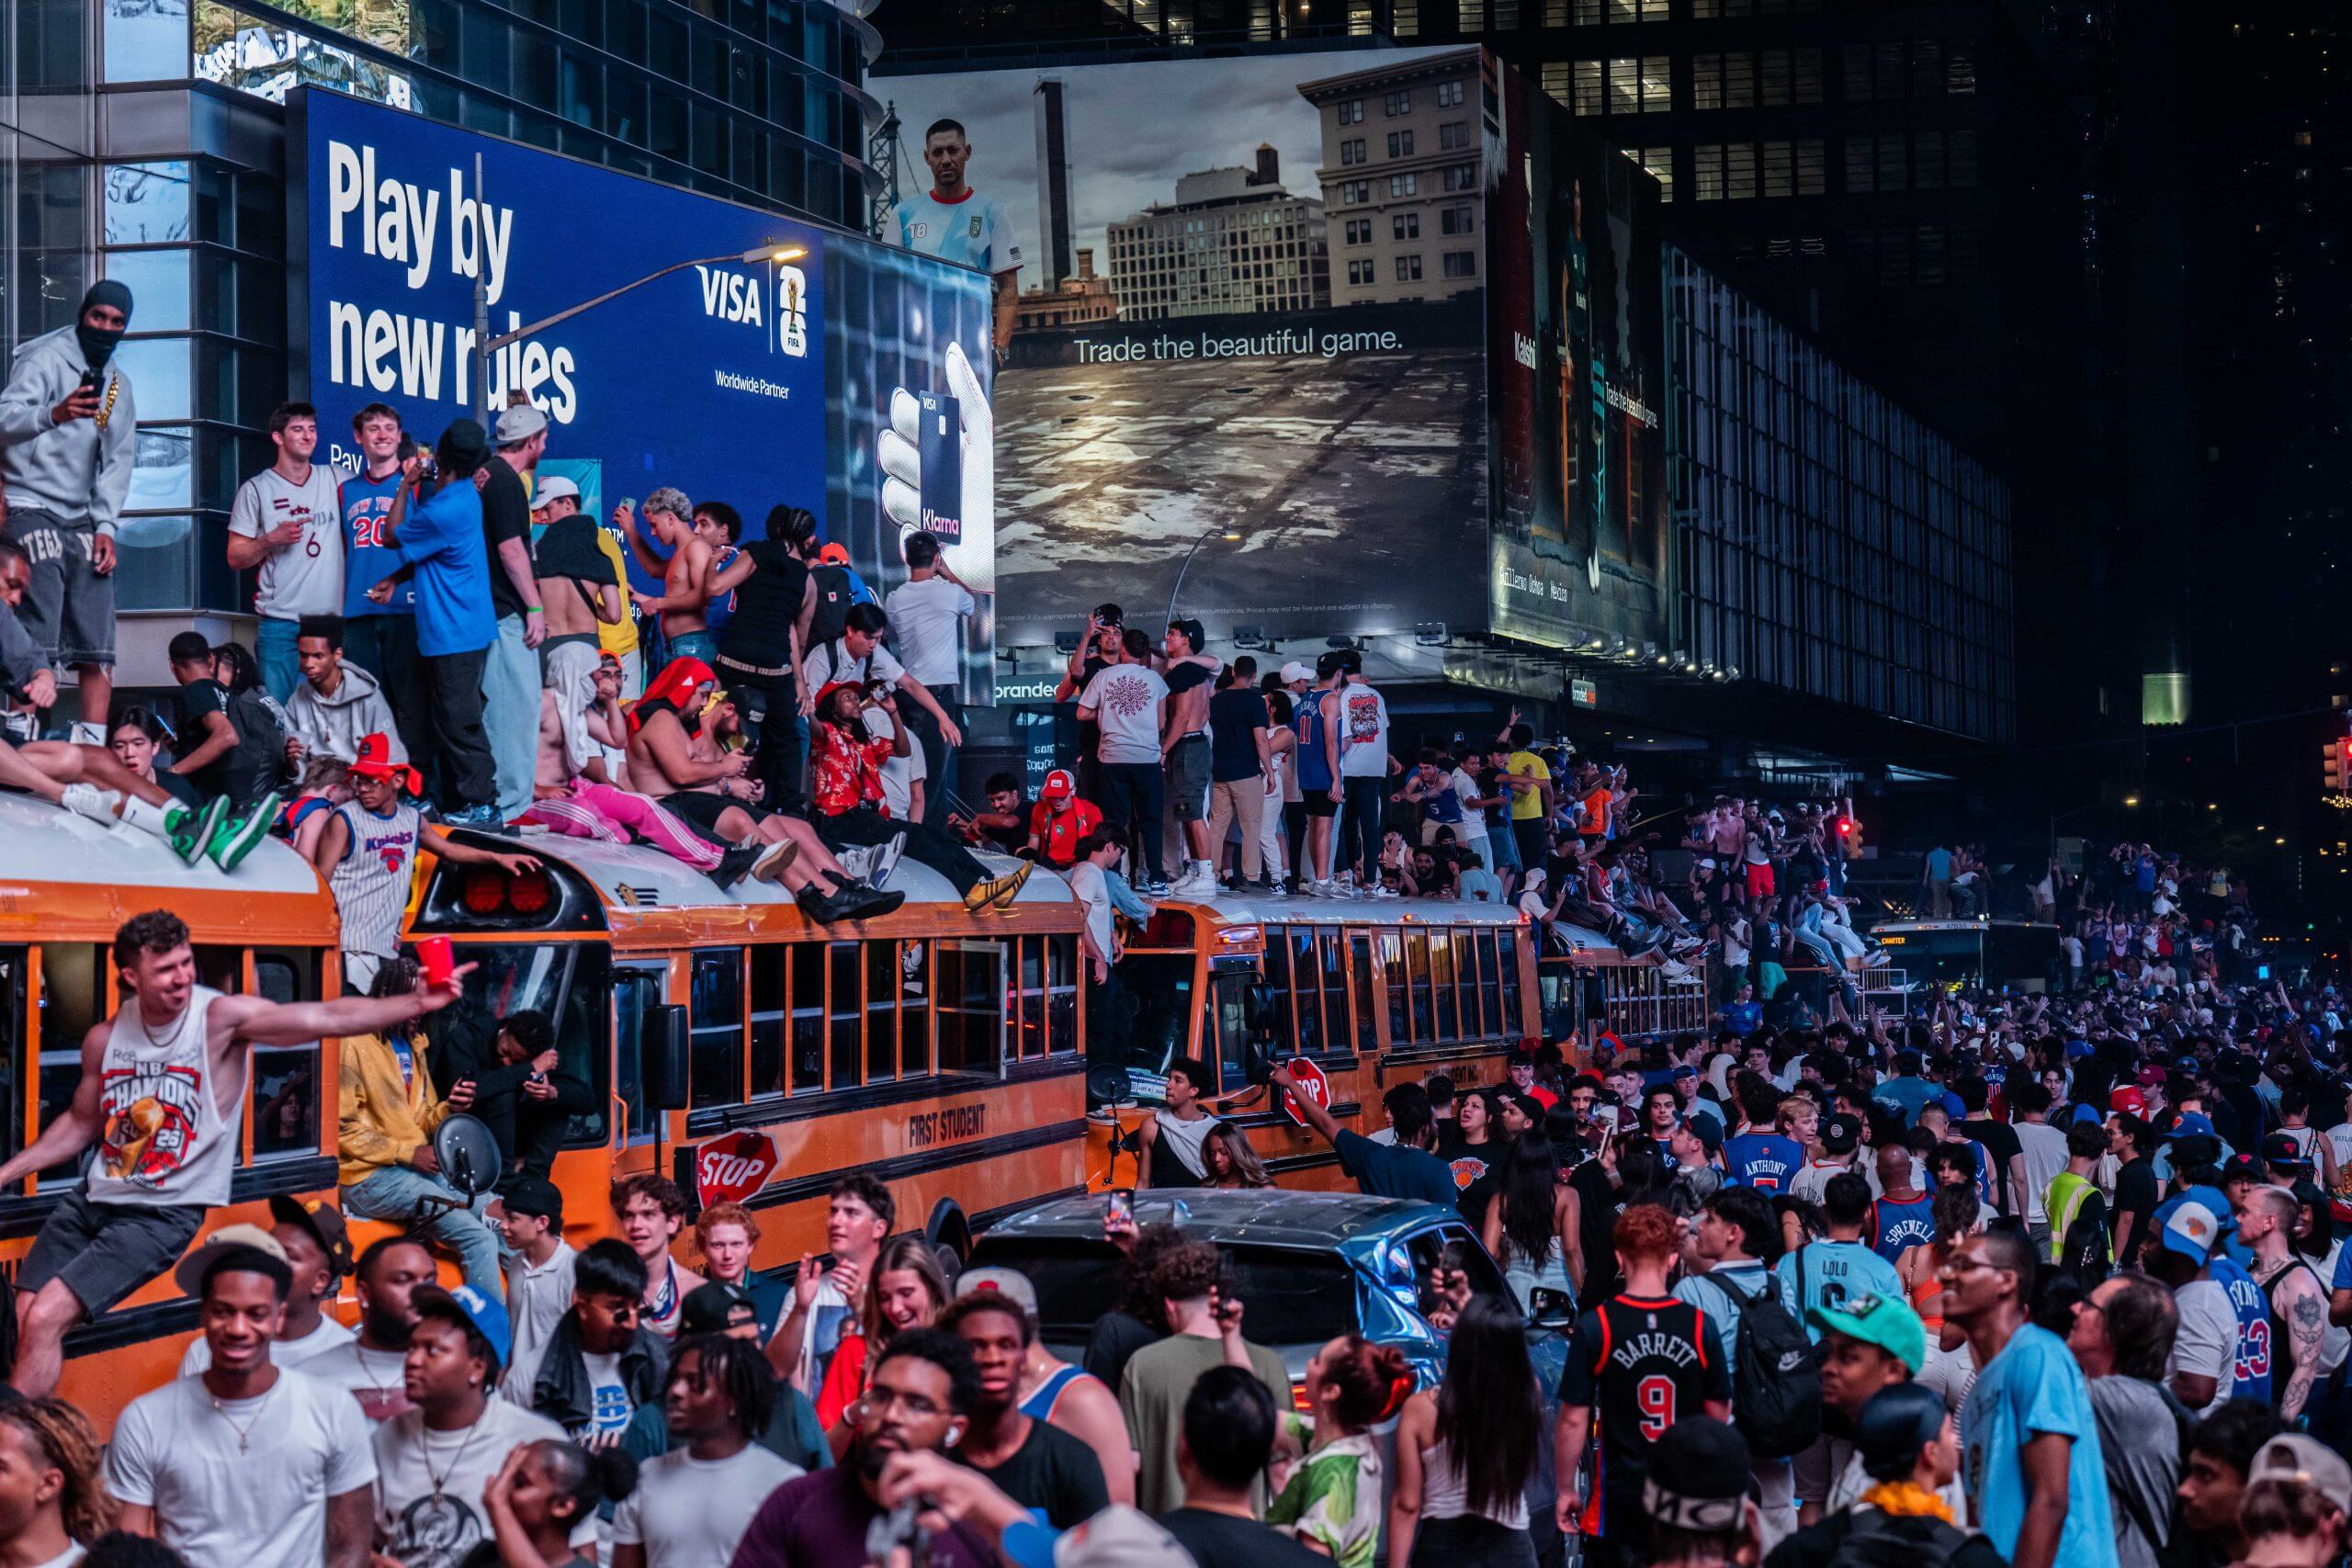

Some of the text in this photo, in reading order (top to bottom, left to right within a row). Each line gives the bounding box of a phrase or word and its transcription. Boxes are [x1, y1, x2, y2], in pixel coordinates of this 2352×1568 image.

[329, 140, 514, 305] Play by
[909, 222, 927, 239] 10
[695, 265, 763, 327] VISA
[787, 337, 800, 348] FIFA
[1073, 327, 1403, 363] Trade the beautiful game.
[1514, 331, 1536, 369] Kalshi
[330, 300, 577, 424] new rules
[715, 369, 790, 400] Worldwide Partner
[922, 397, 937, 412] VISA
[1605, 380, 1619, 408] Trade
[1619, 387, 1627, 412] the
[1626, 390, 1645, 422] beautiful
[375, 496, 395, 513] YO
[922, 508, 960, 536] Klarna
[306, 532, 322, 558] 6
[1266, 606, 1280, 615] may
[1338, 603, 1362, 612] subject
[995, 681, 1057, 698] rande
[1299, 715, 1312, 745] 11
[365, 831, 413, 853] Knicks
[1984, 1073, 2006, 1084] RUNSON
[155, 1128, 182, 1149] 26
[909, 1103, 986, 1148] FIRST STUDENT
[701, 1151, 765, 1188] STOP
[1745, 1159, 1787, 1177] ANTHONY
[1885, 1219, 1936, 1247] SPREWELL
[1822, 1259, 1848, 1277] LOLO
[1612, 1332, 1698, 1370] BARRETT
[1636, 1374, 1676, 1443] 9
